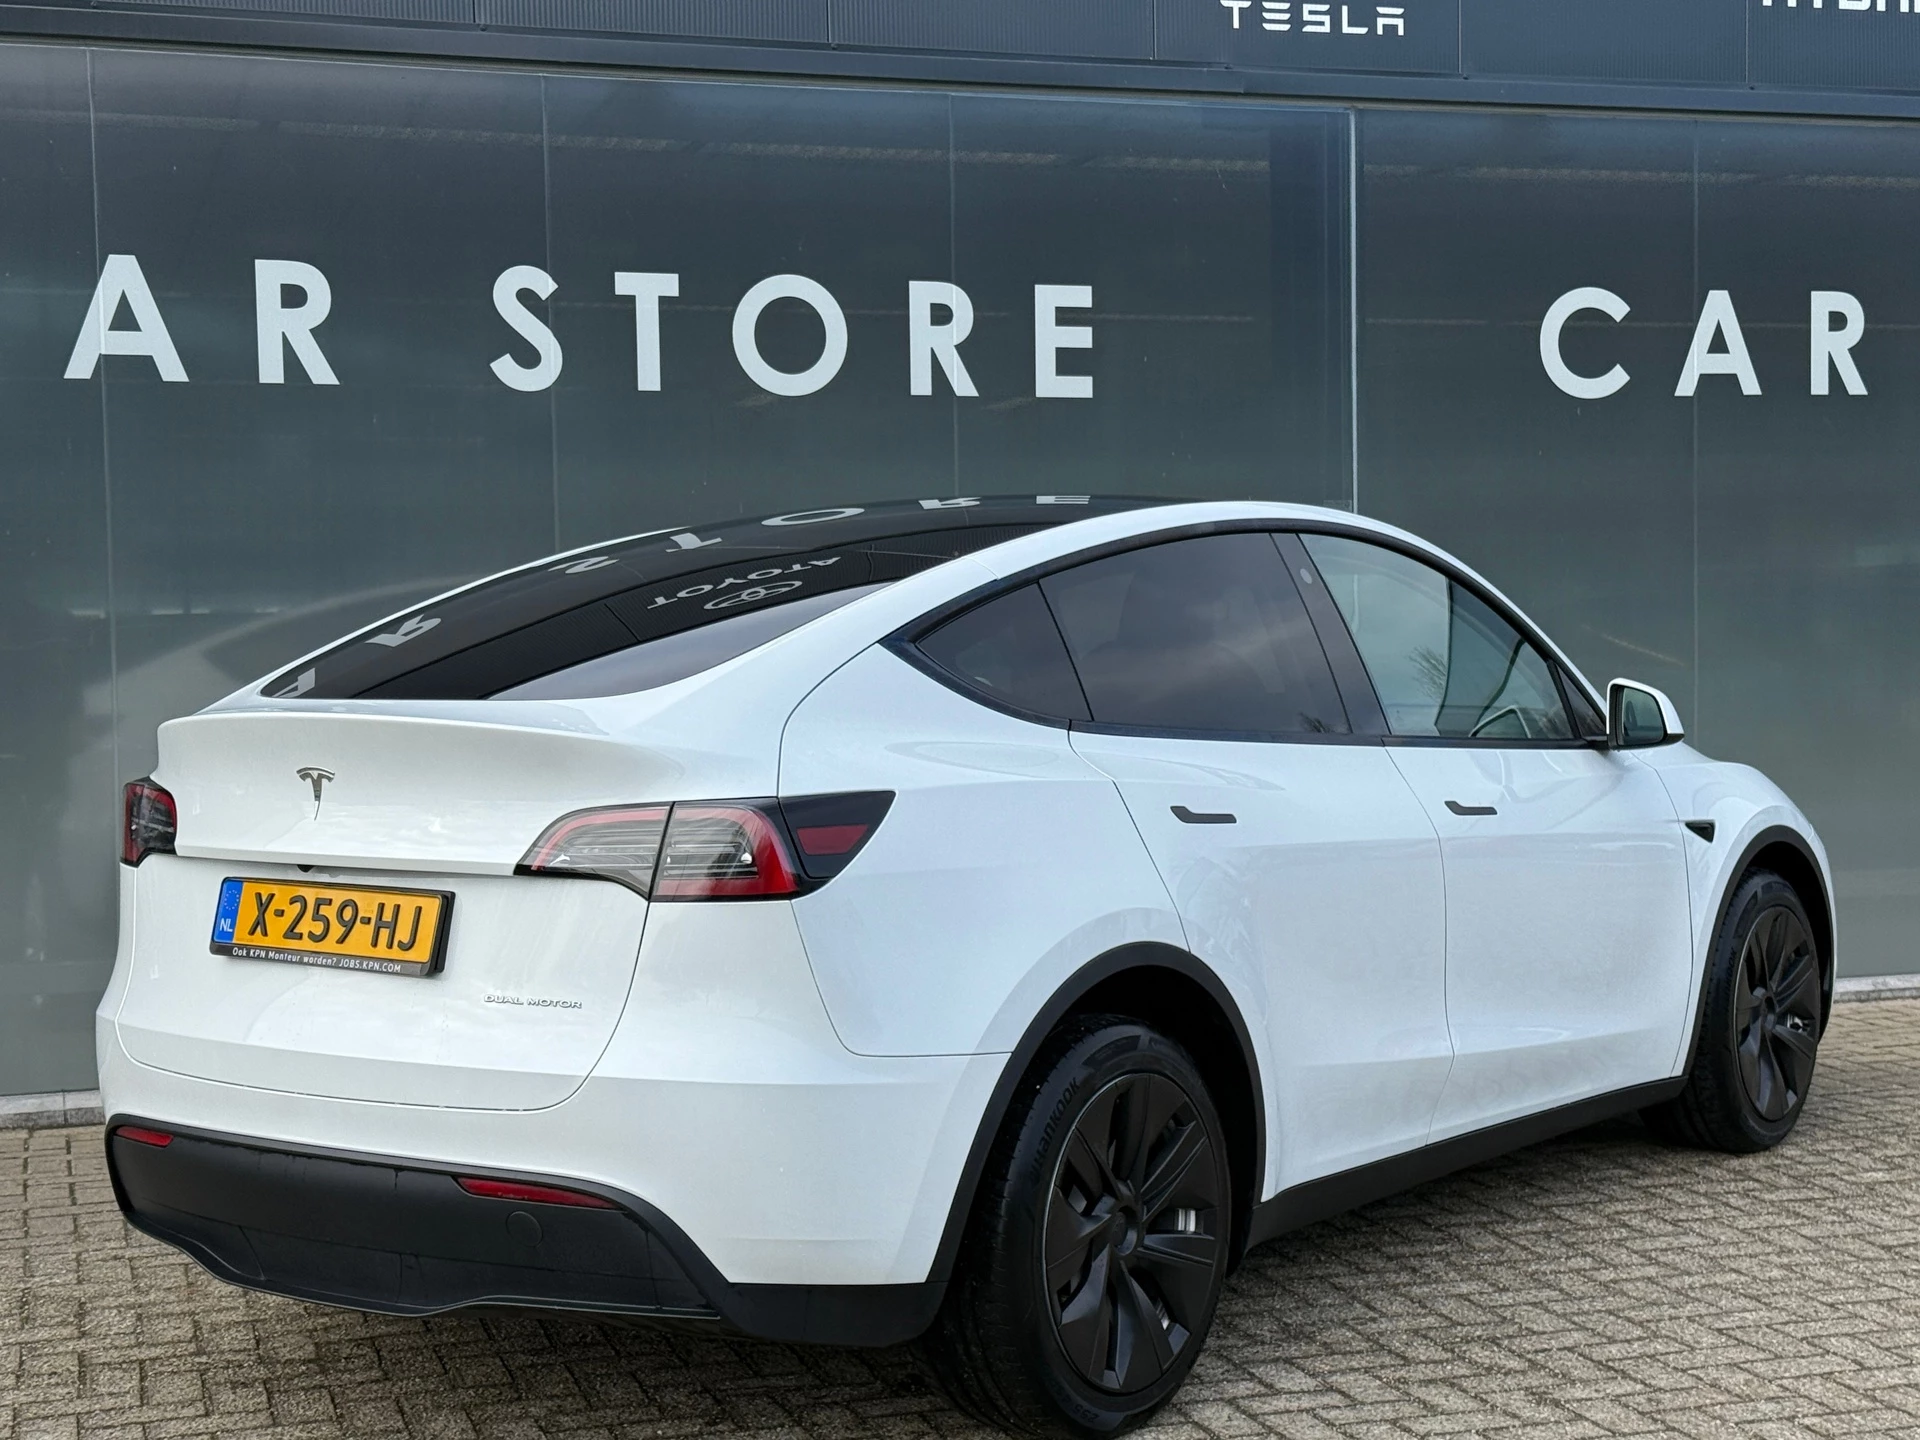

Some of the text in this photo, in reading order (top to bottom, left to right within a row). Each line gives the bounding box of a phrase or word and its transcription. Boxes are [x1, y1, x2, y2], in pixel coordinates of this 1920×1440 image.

[1220, 0, 1405, 36] TESLA
[64, 253, 1094, 399] AR STORE
[1540, 286, 1868, 399] CAR
[219, 917, 233, 932] NL
[247, 891, 423, 951] X-259-HJ
[232, 946, 401, 973] Ook KPN Monteur worden? JOBS.KPN.COM
[484, 994, 582, 1009] DUAL MOTOR
